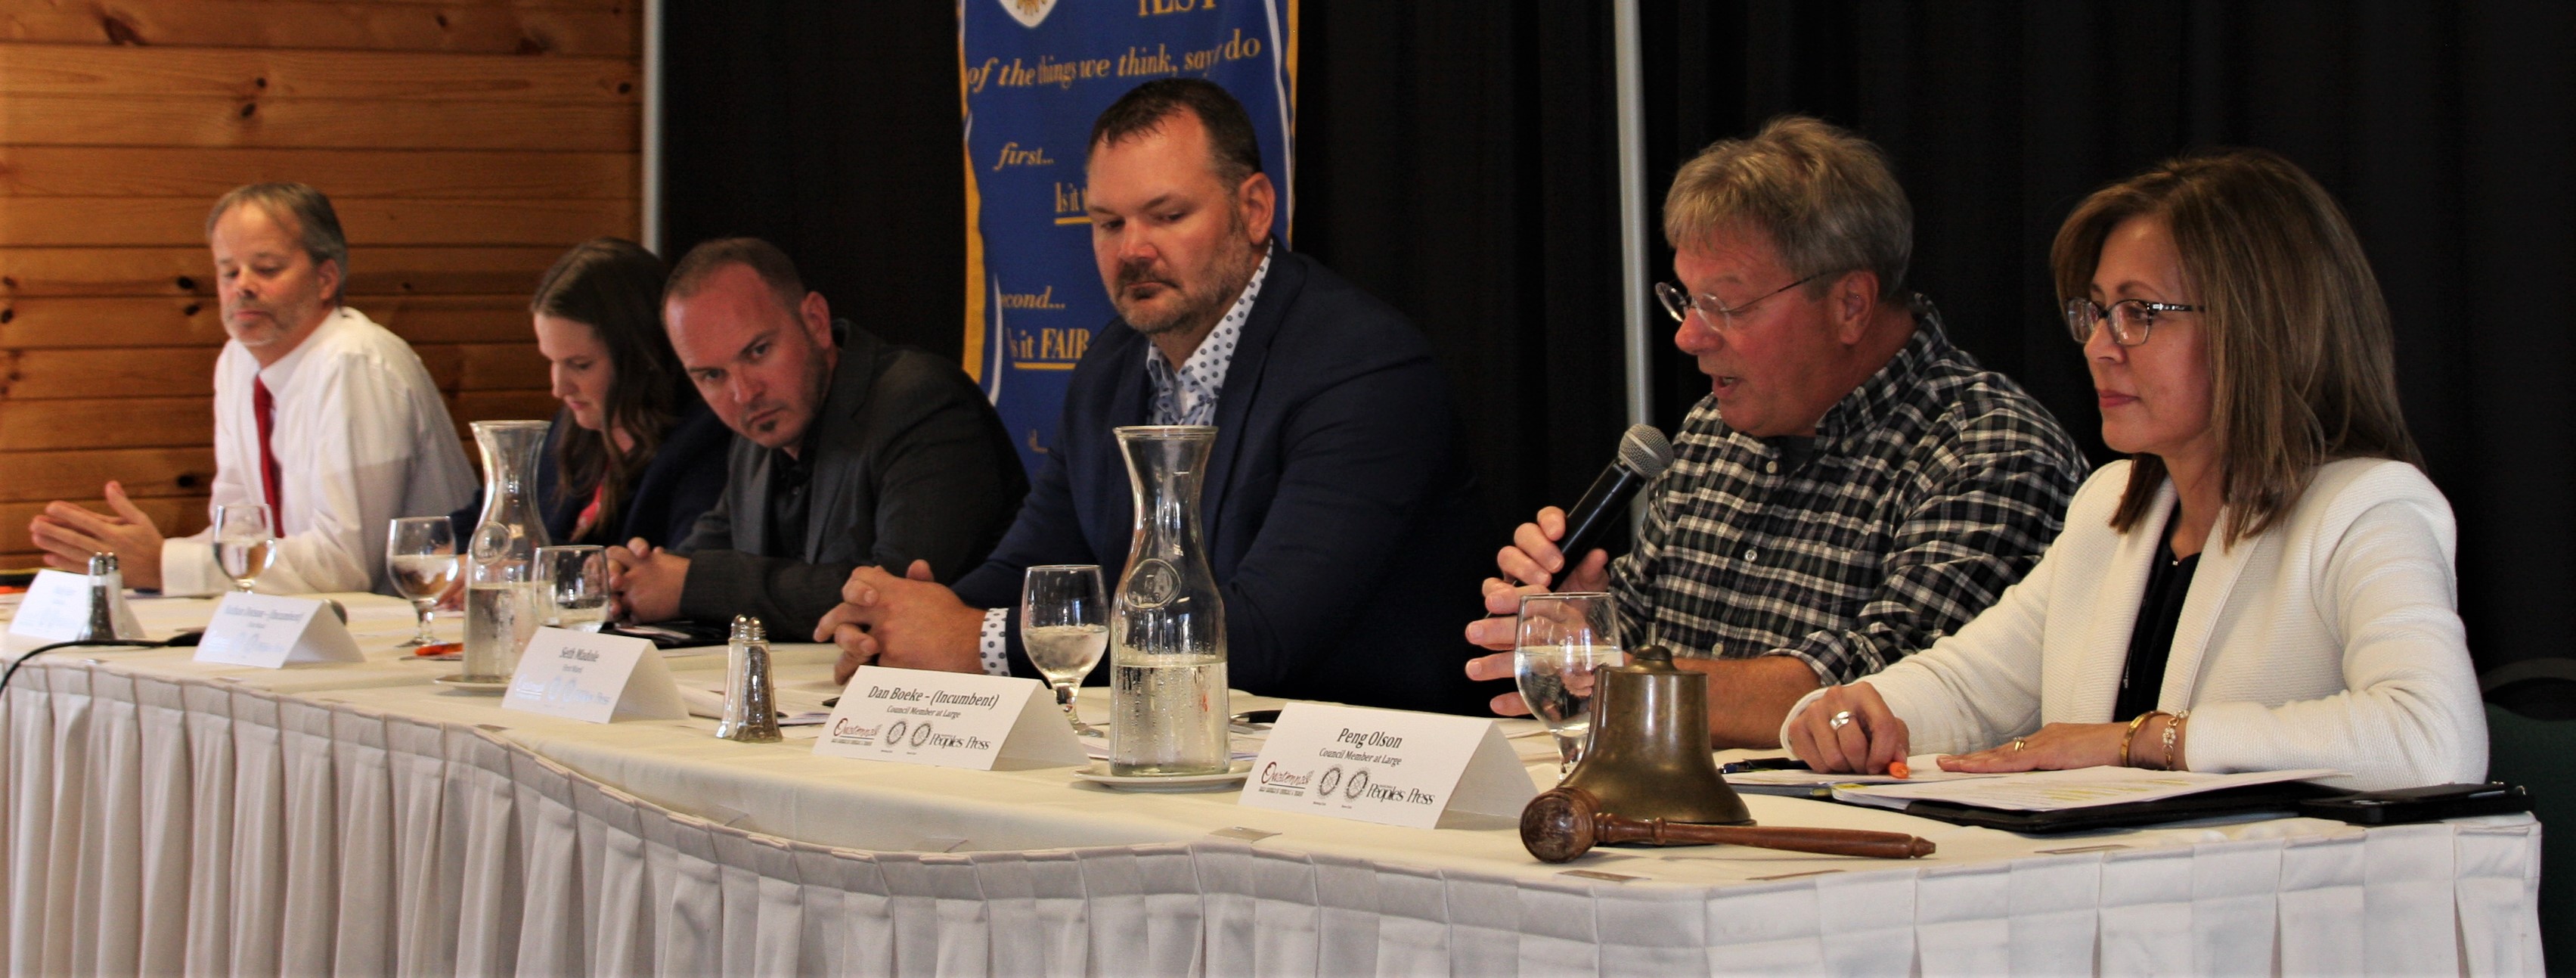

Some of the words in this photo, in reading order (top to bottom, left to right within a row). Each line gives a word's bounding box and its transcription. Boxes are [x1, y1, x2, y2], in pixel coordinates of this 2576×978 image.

[969, 56, 999, 94] of
[997, 57, 1036, 87] the
[1079, 57, 1111, 78] we
[1117, 43, 1179, 77] think,
[1224, 28, 1262, 60] do
[1019, 329, 1034, 359] it
[1040, 327, 1090, 359] FAIR
[867, 685, 890, 699] Dan
[889, 687, 924, 702] Boeke
[930, 690, 1000, 711] (Incumbent)
[886, 705, 910, 715] Council
[910, 706, 935, 716] Member
[935, 709, 943, 717] at
[941, 709, 962, 719] Large
[966, 736, 991, 750] Press
[1336, 728, 1369, 749] Peng
[1368, 731, 1403, 749] Olson
[1319, 747, 1345, 759] Council
[1344, 750, 1375, 762] Member
[1373, 755, 1382, 763] at
[1381, 754, 1403, 767] Large
[1406, 787, 1436, 805] Press
